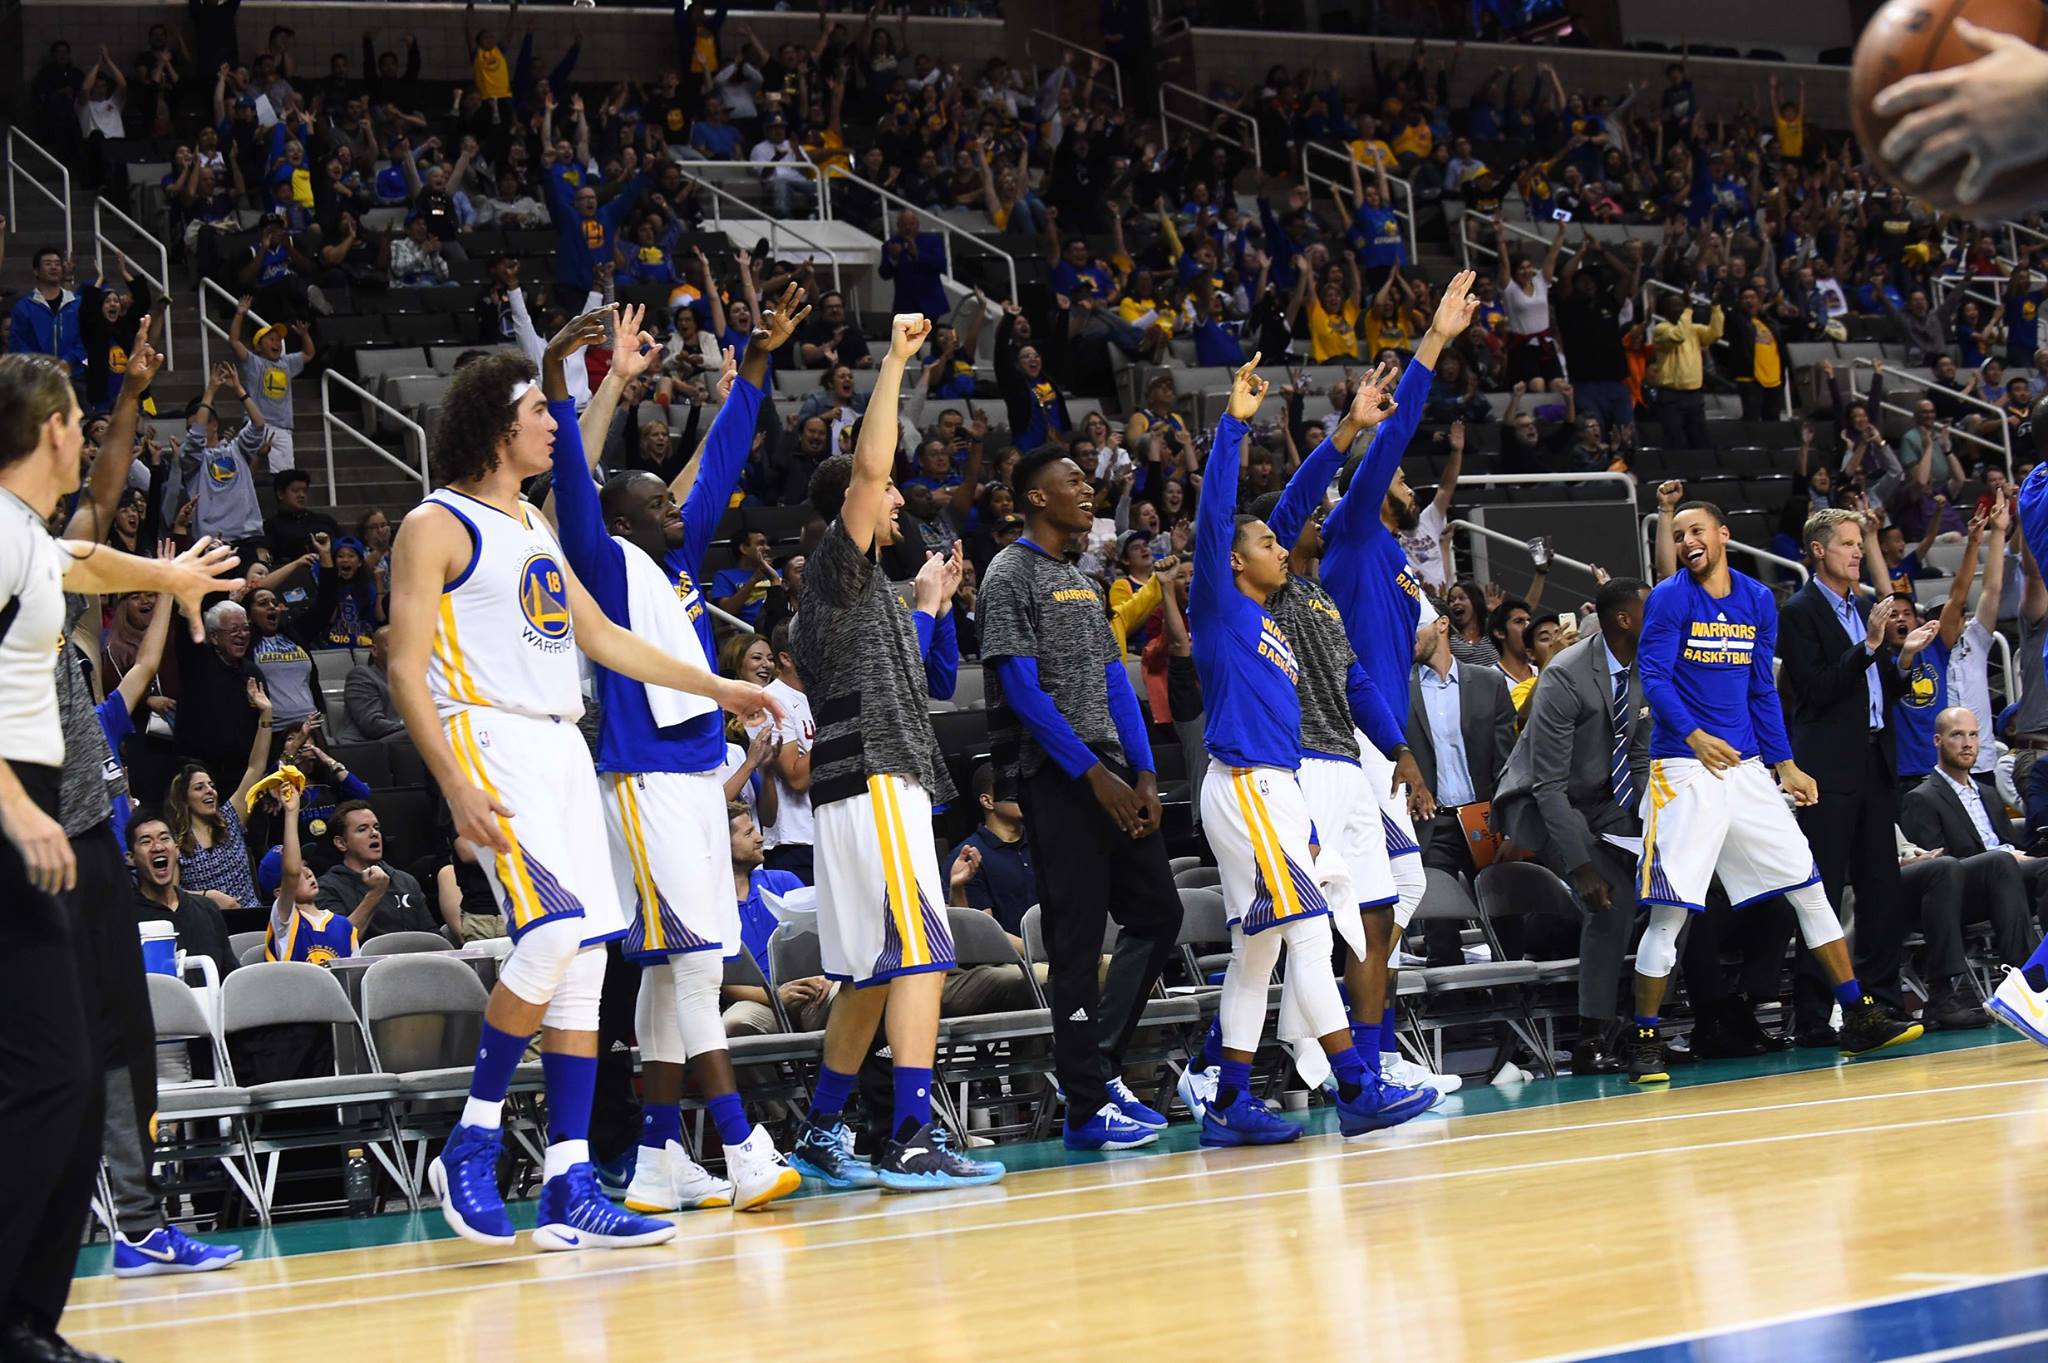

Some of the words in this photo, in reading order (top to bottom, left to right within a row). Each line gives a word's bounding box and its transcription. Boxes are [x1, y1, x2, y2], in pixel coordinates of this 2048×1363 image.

[546, 571, 562, 593] 18
[1691, 621, 1757, 640] WARRIORS
[1683, 647, 1753, 665] BASKETBALL
